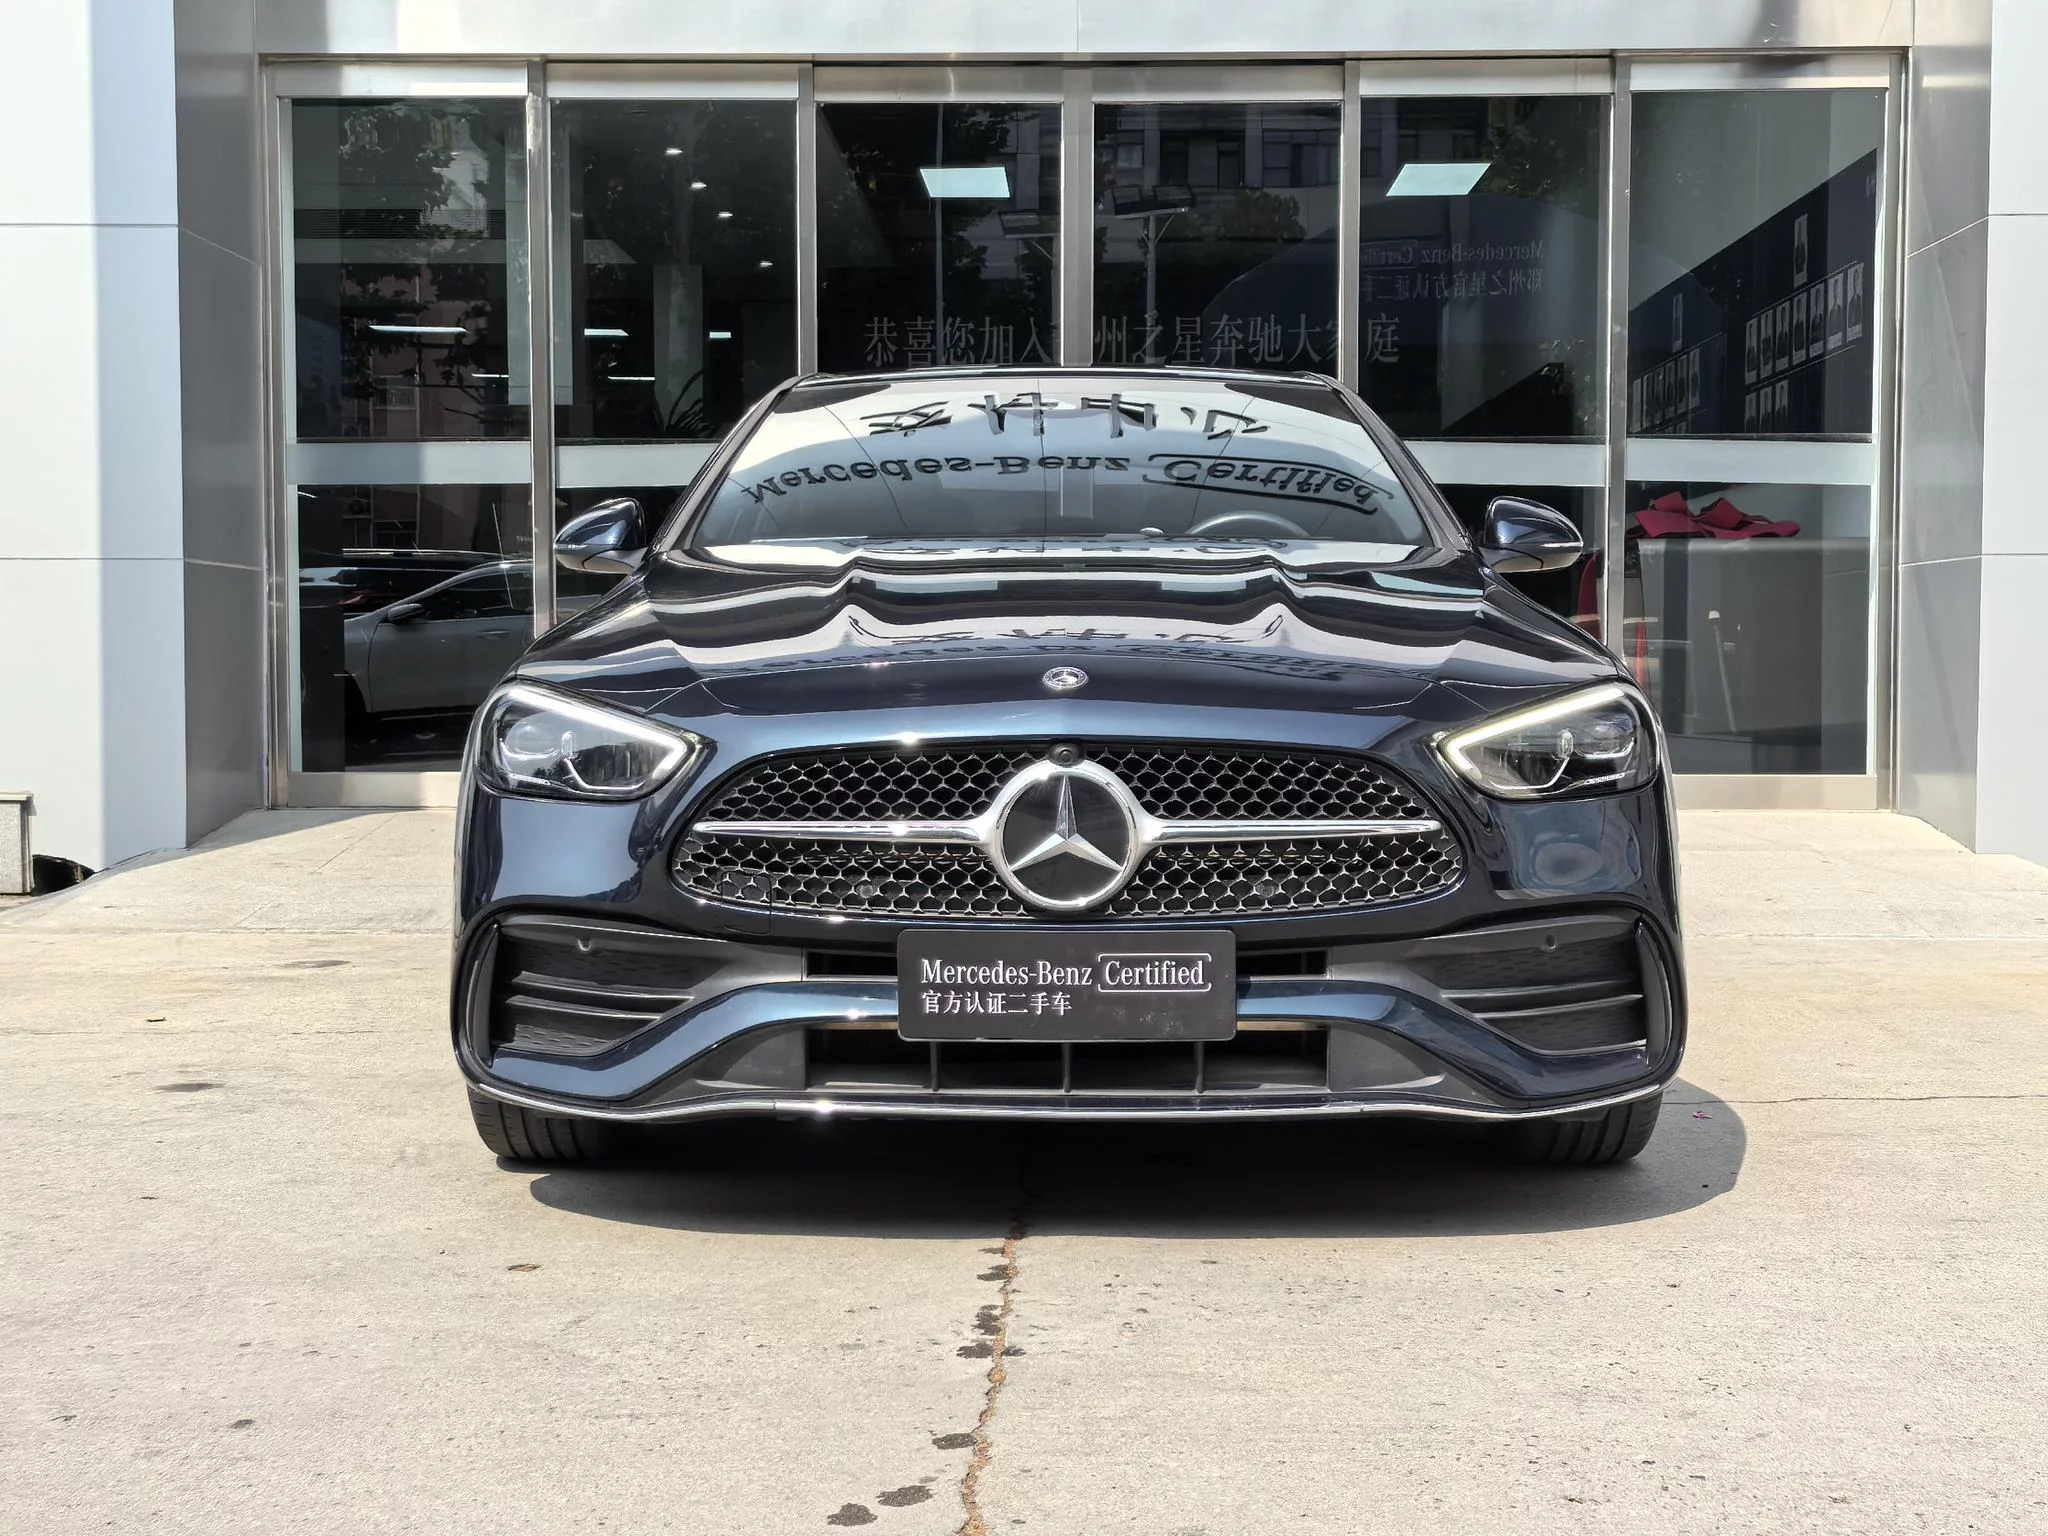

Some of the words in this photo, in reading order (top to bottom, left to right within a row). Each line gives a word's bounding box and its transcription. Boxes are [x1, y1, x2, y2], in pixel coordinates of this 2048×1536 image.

[863, 312, 1400, 366] 恭喜您加入州之星奔驰大庭
[921, 958, 1093, 986] Mercedes-Benz
[1104, 960, 1205, 986] Certified
[921, 989, 1073, 1015] 官方认证二手车
